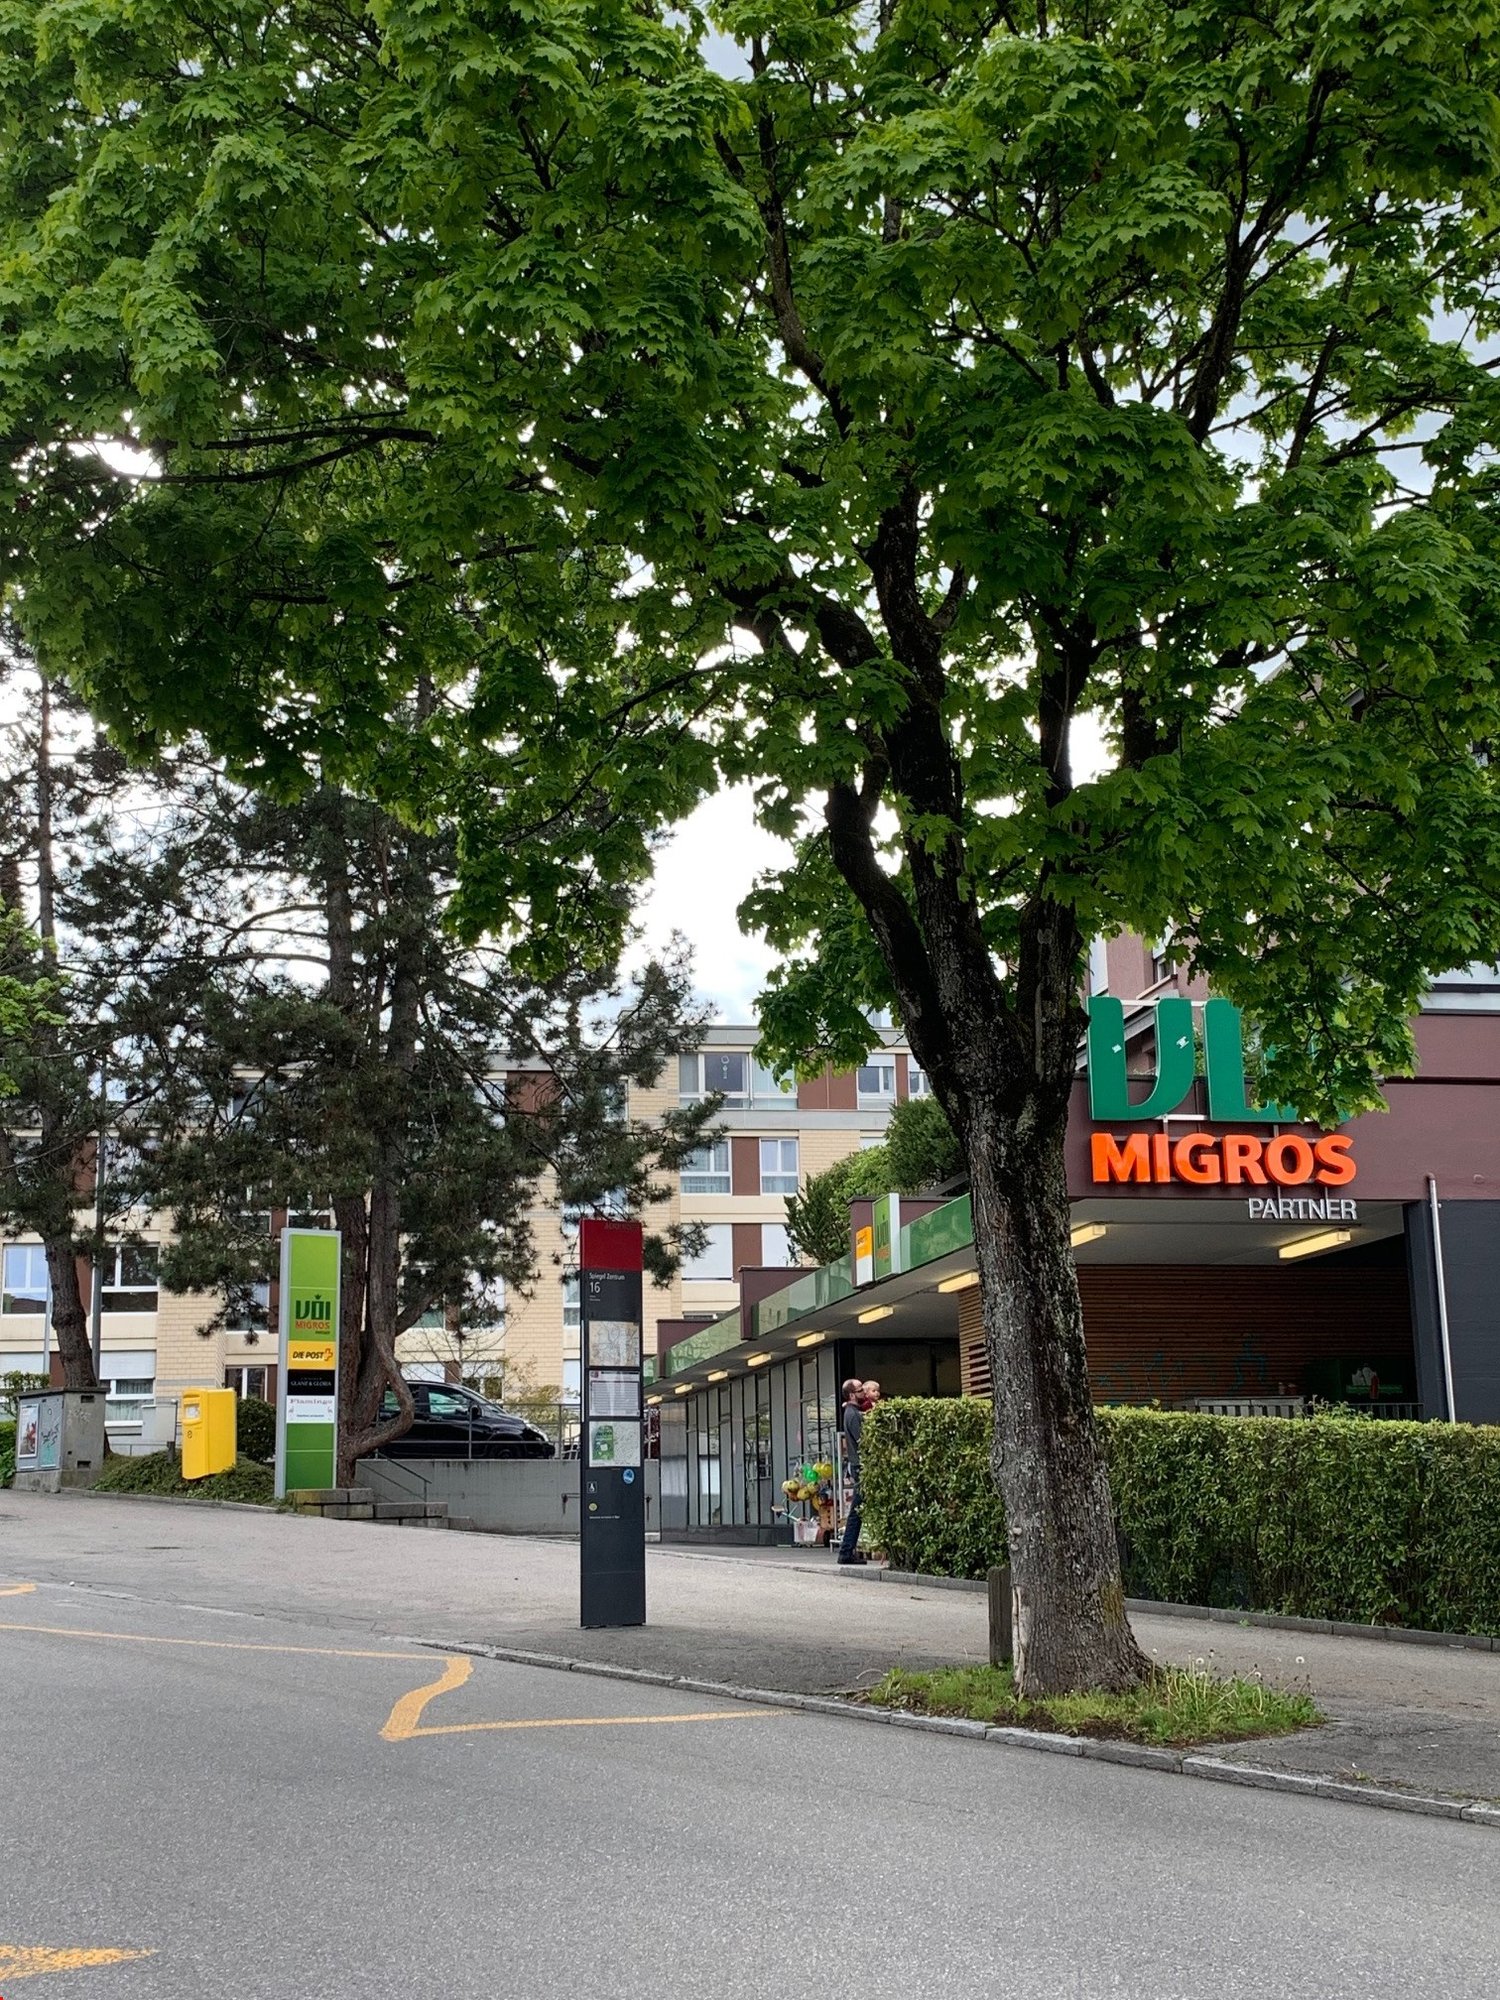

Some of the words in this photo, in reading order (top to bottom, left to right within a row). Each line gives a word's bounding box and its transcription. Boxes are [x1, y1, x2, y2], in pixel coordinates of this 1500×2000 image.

[1091, 1132, 1357, 1186] MIGROS
[1248, 1197, 1358, 1220] PARTNER
[589, 1281, 601, 1294] 16
[295, 1320, 330, 1330] MIGROS
[292, 1350, 304, 1360] DIE
[305, 1350, 324, 1360] POST
